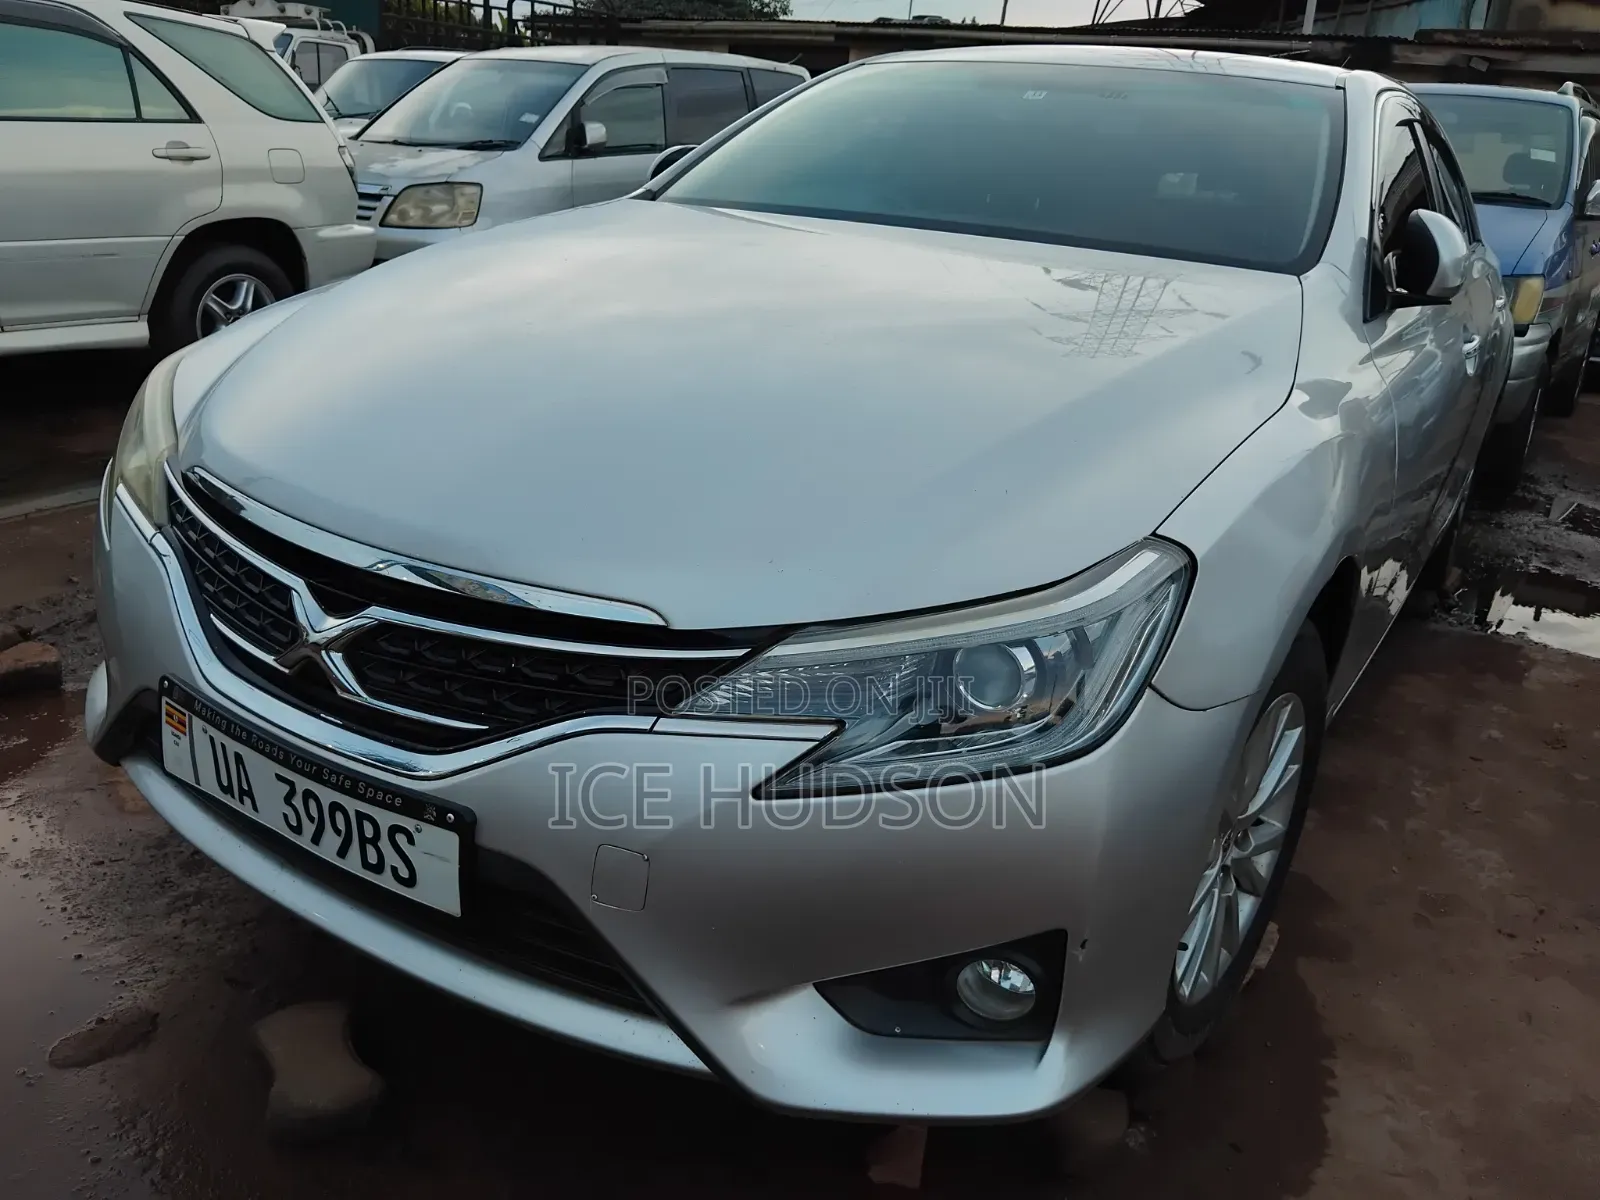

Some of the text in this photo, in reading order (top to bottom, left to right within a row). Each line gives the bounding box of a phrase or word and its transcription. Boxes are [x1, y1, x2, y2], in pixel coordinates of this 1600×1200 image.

[193, 699, 402, 807] Making the Roads Your Safe Space
[208, 733, 418, 889] UA 399BS
